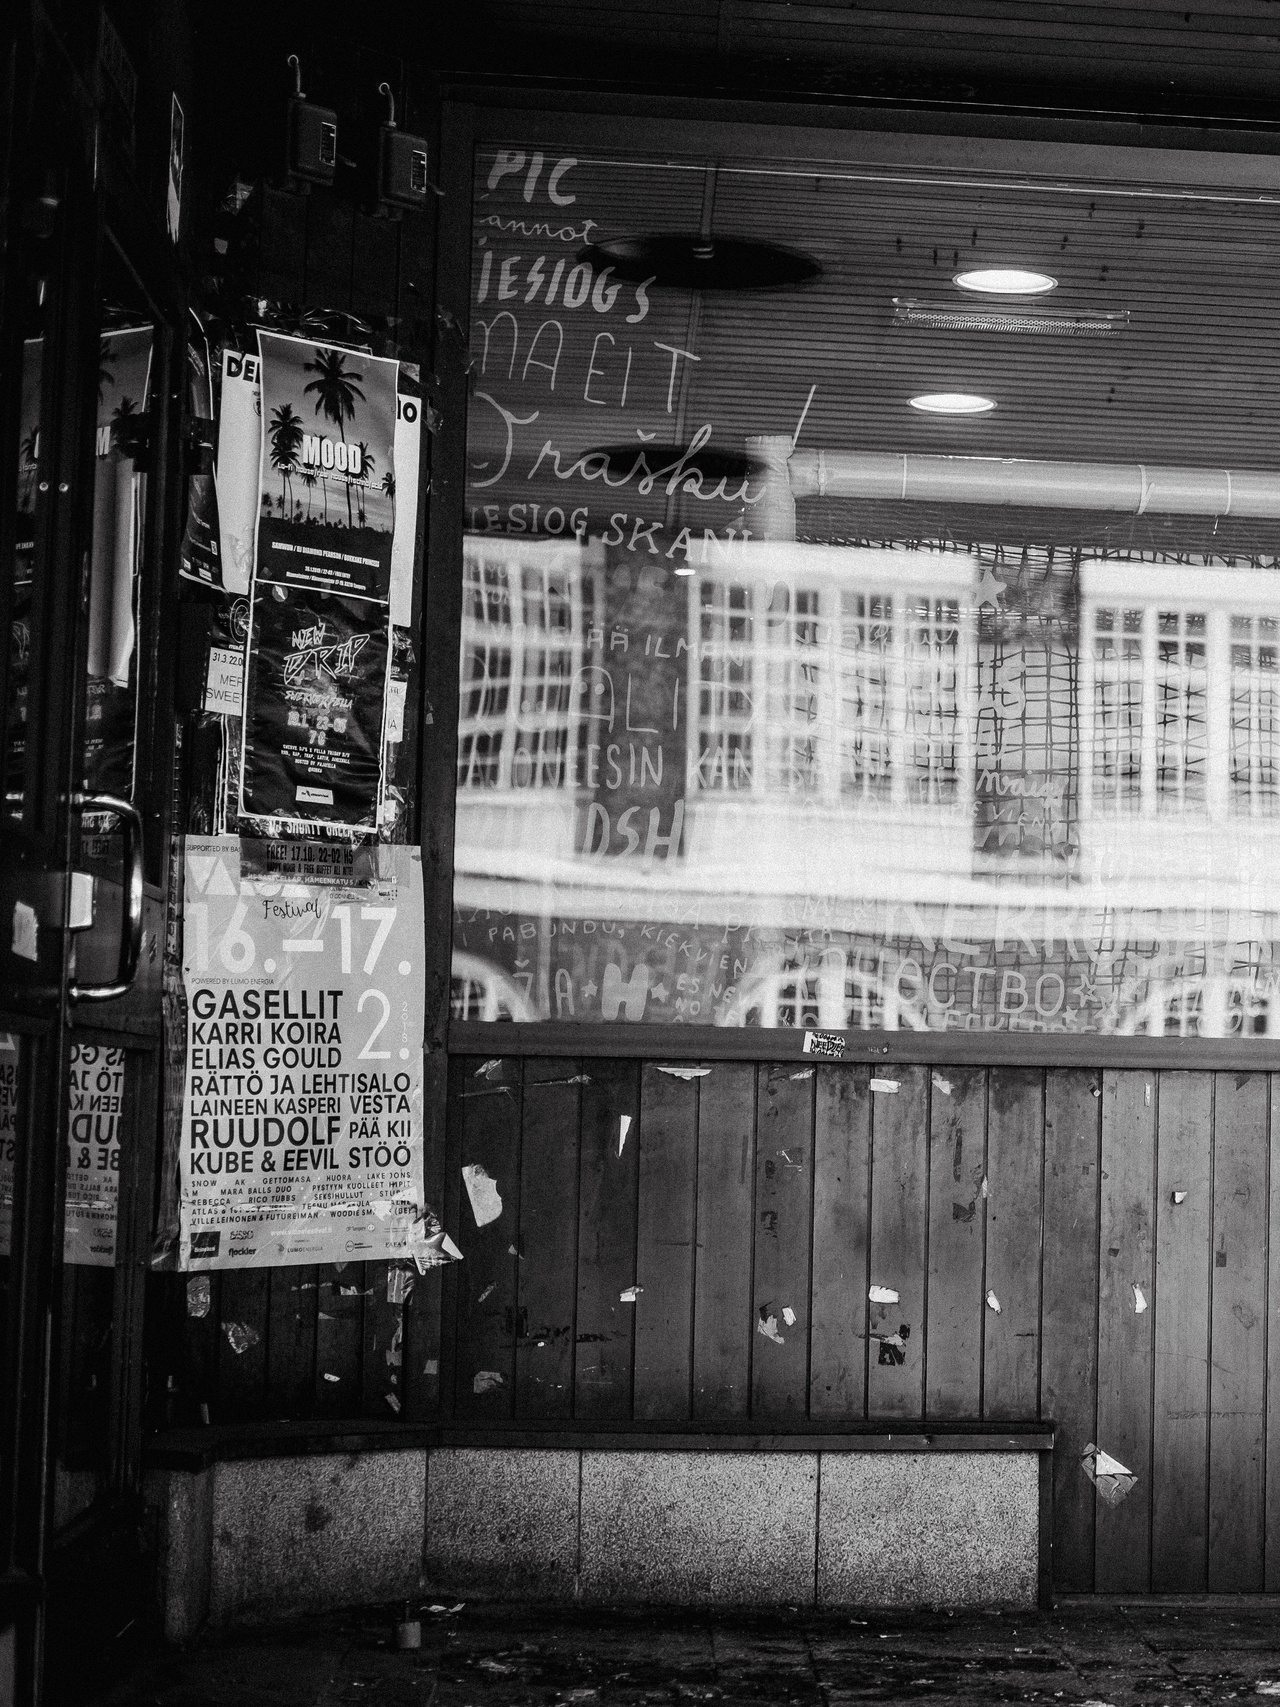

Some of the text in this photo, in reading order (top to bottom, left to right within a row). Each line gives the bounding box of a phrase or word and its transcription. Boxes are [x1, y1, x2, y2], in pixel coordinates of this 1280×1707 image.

[302, 434, 362, 475] MOOD
[187, 844, 219, 852] SUPPORTED
[266, 844, 340, 863] FREE! 22-02
[304, 864, 314, 874] FREE
[262, 899, 321, 919] Festival
[192, 989, 343, 1020] GASELLIT
[191, 1022, 342, 1045] KARRI KOIRA
[191, 1047, 342, 1070] ELIAS GOULD
[191, 1070, 411, 1096] RÄTTÖ JA LEHTISALO
[191, 1094, 411, 1117] LAINEEN KASPERI VESTA
[191, 1116, 411, 1149] RUUDOLF PÄÄ KII
[191, 1141, 411, 1175] KUBE & EEVIL STÖÖ
[220, 1188, 243, 1196] MARA
[276, 1185, 292, 1193] DUO
[312, 1183, 343, 1191] PYSTYYN
[347, 1181, 384, 1190] KUOLLEET
[263, 1176, 311, 1185] GETTOMASA
[326, 1174, 351, 1182] HUORA
[367, 1172, 385, 1180] LAKE
[389, 1171, 411, 1179] JONS
[191, 1198, 231, 1206] REBECCA
[314, 1191, 363, 1200] SEKSIHULLUT
[216, 1215, 256, 1224] LEINONEN
[266, 1212, 318, 1221] FUTUREIMAN
[330, 1209, 359, 1218] WOODIE
